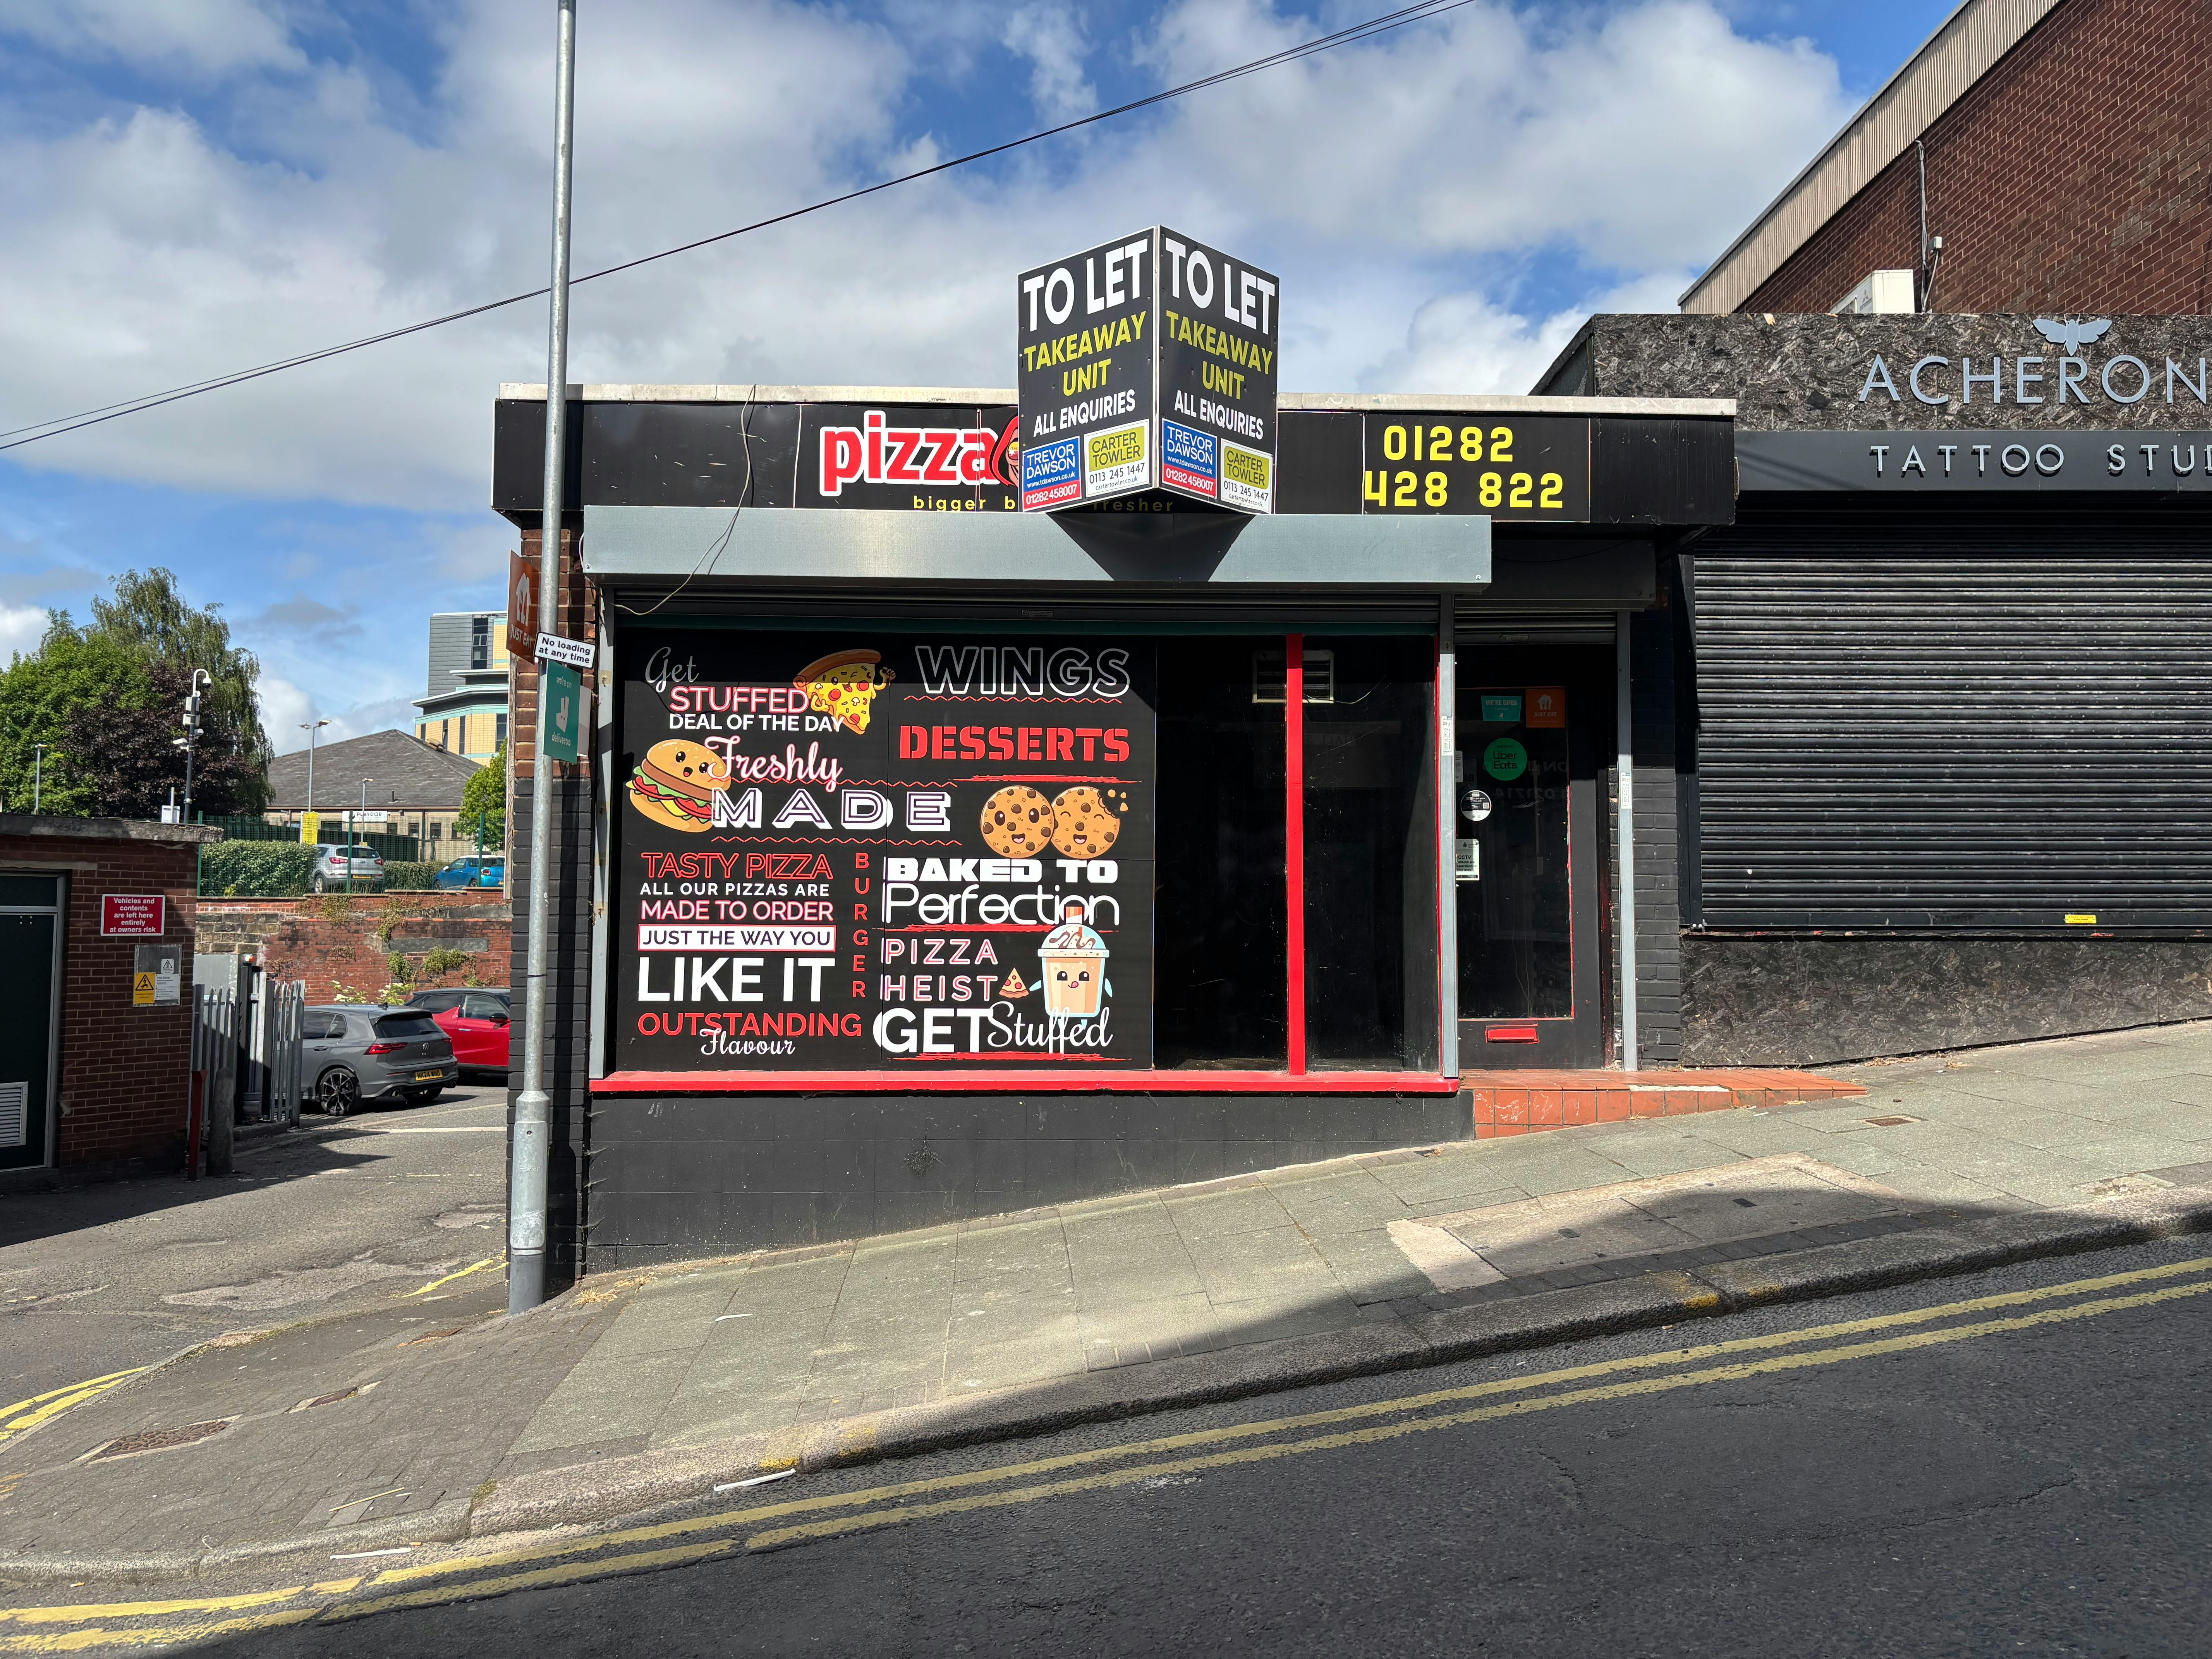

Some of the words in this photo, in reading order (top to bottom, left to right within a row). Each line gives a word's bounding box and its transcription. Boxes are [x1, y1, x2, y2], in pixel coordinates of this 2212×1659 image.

[1024, 267, 1075, 331] TO
[1087, 238, 1147, 314] LET
[1165, 237, 1213, 309] TO
[1224, 263, 1275, 335] LET
[1024, 311, 1146, 372] TAKEAWAY
[1166, 310, 1273, 375] TAKEAWAY
[1063, 358, 1111, 397] UNIT
[1202, 361, 1244, 400] UNIT
[1859, 354, 2206, 405] ACHERON
[1033, 413, 1056, 437] ALL
[1060, 389, 1136, 430] ENQUIRIES
[1174, 390, 1196, 418] ALL
[1200, 398, 1263, 440] ENQUIRIES
[1092, 432, 1137, 453] CARTER
[1167, 426, 1212, 452] TREVOR
[1167, 439, 1212, 465] DAWSON
[1384, 426, 1513, 462] 01282
[819, 410, 1000, 496] pizza
[1027, 444, 1074, 466] TREVOR
[1093, 445, 1140, 467] TOWLER
[1167, 456, 1212, 475] www.tdawson.co.uk
[1227, 450, 1262, 472] CARTER
[1870, 443, 2064, 472] TATTOO
[1027, 456, 1075, 479] DAWSON
[1027, 471, 1075, 488] www.tdawson.co.uk
[1089, 472, 1106, 484] 0113
[1109, 467, 1124, 479] 245
[1127, 462, 1145, 476] 1447
[1166, 468, 1187, 484] 01282
[1188, 475, 1214, 491] 458007
[1227, 463, 1265, 486] TOWLER
[1026, 491, 1049, 505] 01282
[1049, 484, 1077, 499] 458007
[1096, 475, 1138, 491] cartertowler.co.uk
[1224, 481, 1237, 492] 0113
[1240, 485, 1251, 496] 245
[1254, 489, 1269, 501] 1447
[1365, 471, 1448, 507] 428
[1479, 472, 1563, 508] 822
[914, 496, 986, 511] bigger
[510, 624, 523, 642] JUST
[523, 633, 532, 648] EAT
[542, 637, 555, 646] No
[558, 641, 590, 655] loading
[551, 650, 567, 659] any
[570, 654, 590, 663] time
[645, 647, 699, 692] Get
[556, 676, 567, 686] we're
[915, 646, 1130, 697] WINGS
[670, 686, 809, 714] STUFFED
[670, 714, 722, 730] DEAL
[726, 714, 755, 730] OF
[759, 715, 799, 732] THE
[805, 716, 845, 732] DAY
[552, 732, 571, 746] deliveroo
[900, 725, 1130, 762] DESSERTS
[704, 735, 843, 793] Freshly
[1493, 751, 1517, 759] Uber
[1493, 761, 1518, 769] Eats
[711, 787, 951, 831] MADE
[641, 852, 739, 878] TASTY
[746, 854, 833, 879] PIZZA
[883, 856, 1042, 882] BAKED
[1056, 859, 1118, 883] TO
[640, 882, 673, 895] ALL
[680, 883, 718, 896] OUR
[726, 883, 788, 896] PIZZAS
[795, 883, 830, 896] ARE
[641, 900, 709, 920] MADE
[715, 900, 747, 921] TO
[753, 901, 833, 921] ORDER
[881, 883, 1120, 926] Perfection
[643, 930, 692, 945] JUST
[697, 931, 735, 945] THE
[740, 931, 783, 945] WAY
[790, 931, 830, 946] YOU
[852, 852, 870, 998] BURGER
[881, 938, 998, 965] PIZZA
[638, 957, 764, 1001] LIKE
[783, 958, 835, 1002] IT
[880, 974, 998, 1001] HEIST
[638, 1012, 861, 1037] OUTSTANDING
[873, 1008, 994, 1053] GET
[987, 1001, 1113, 1055] Stuffed
[699, 1027, 795, 1055] Flavour
